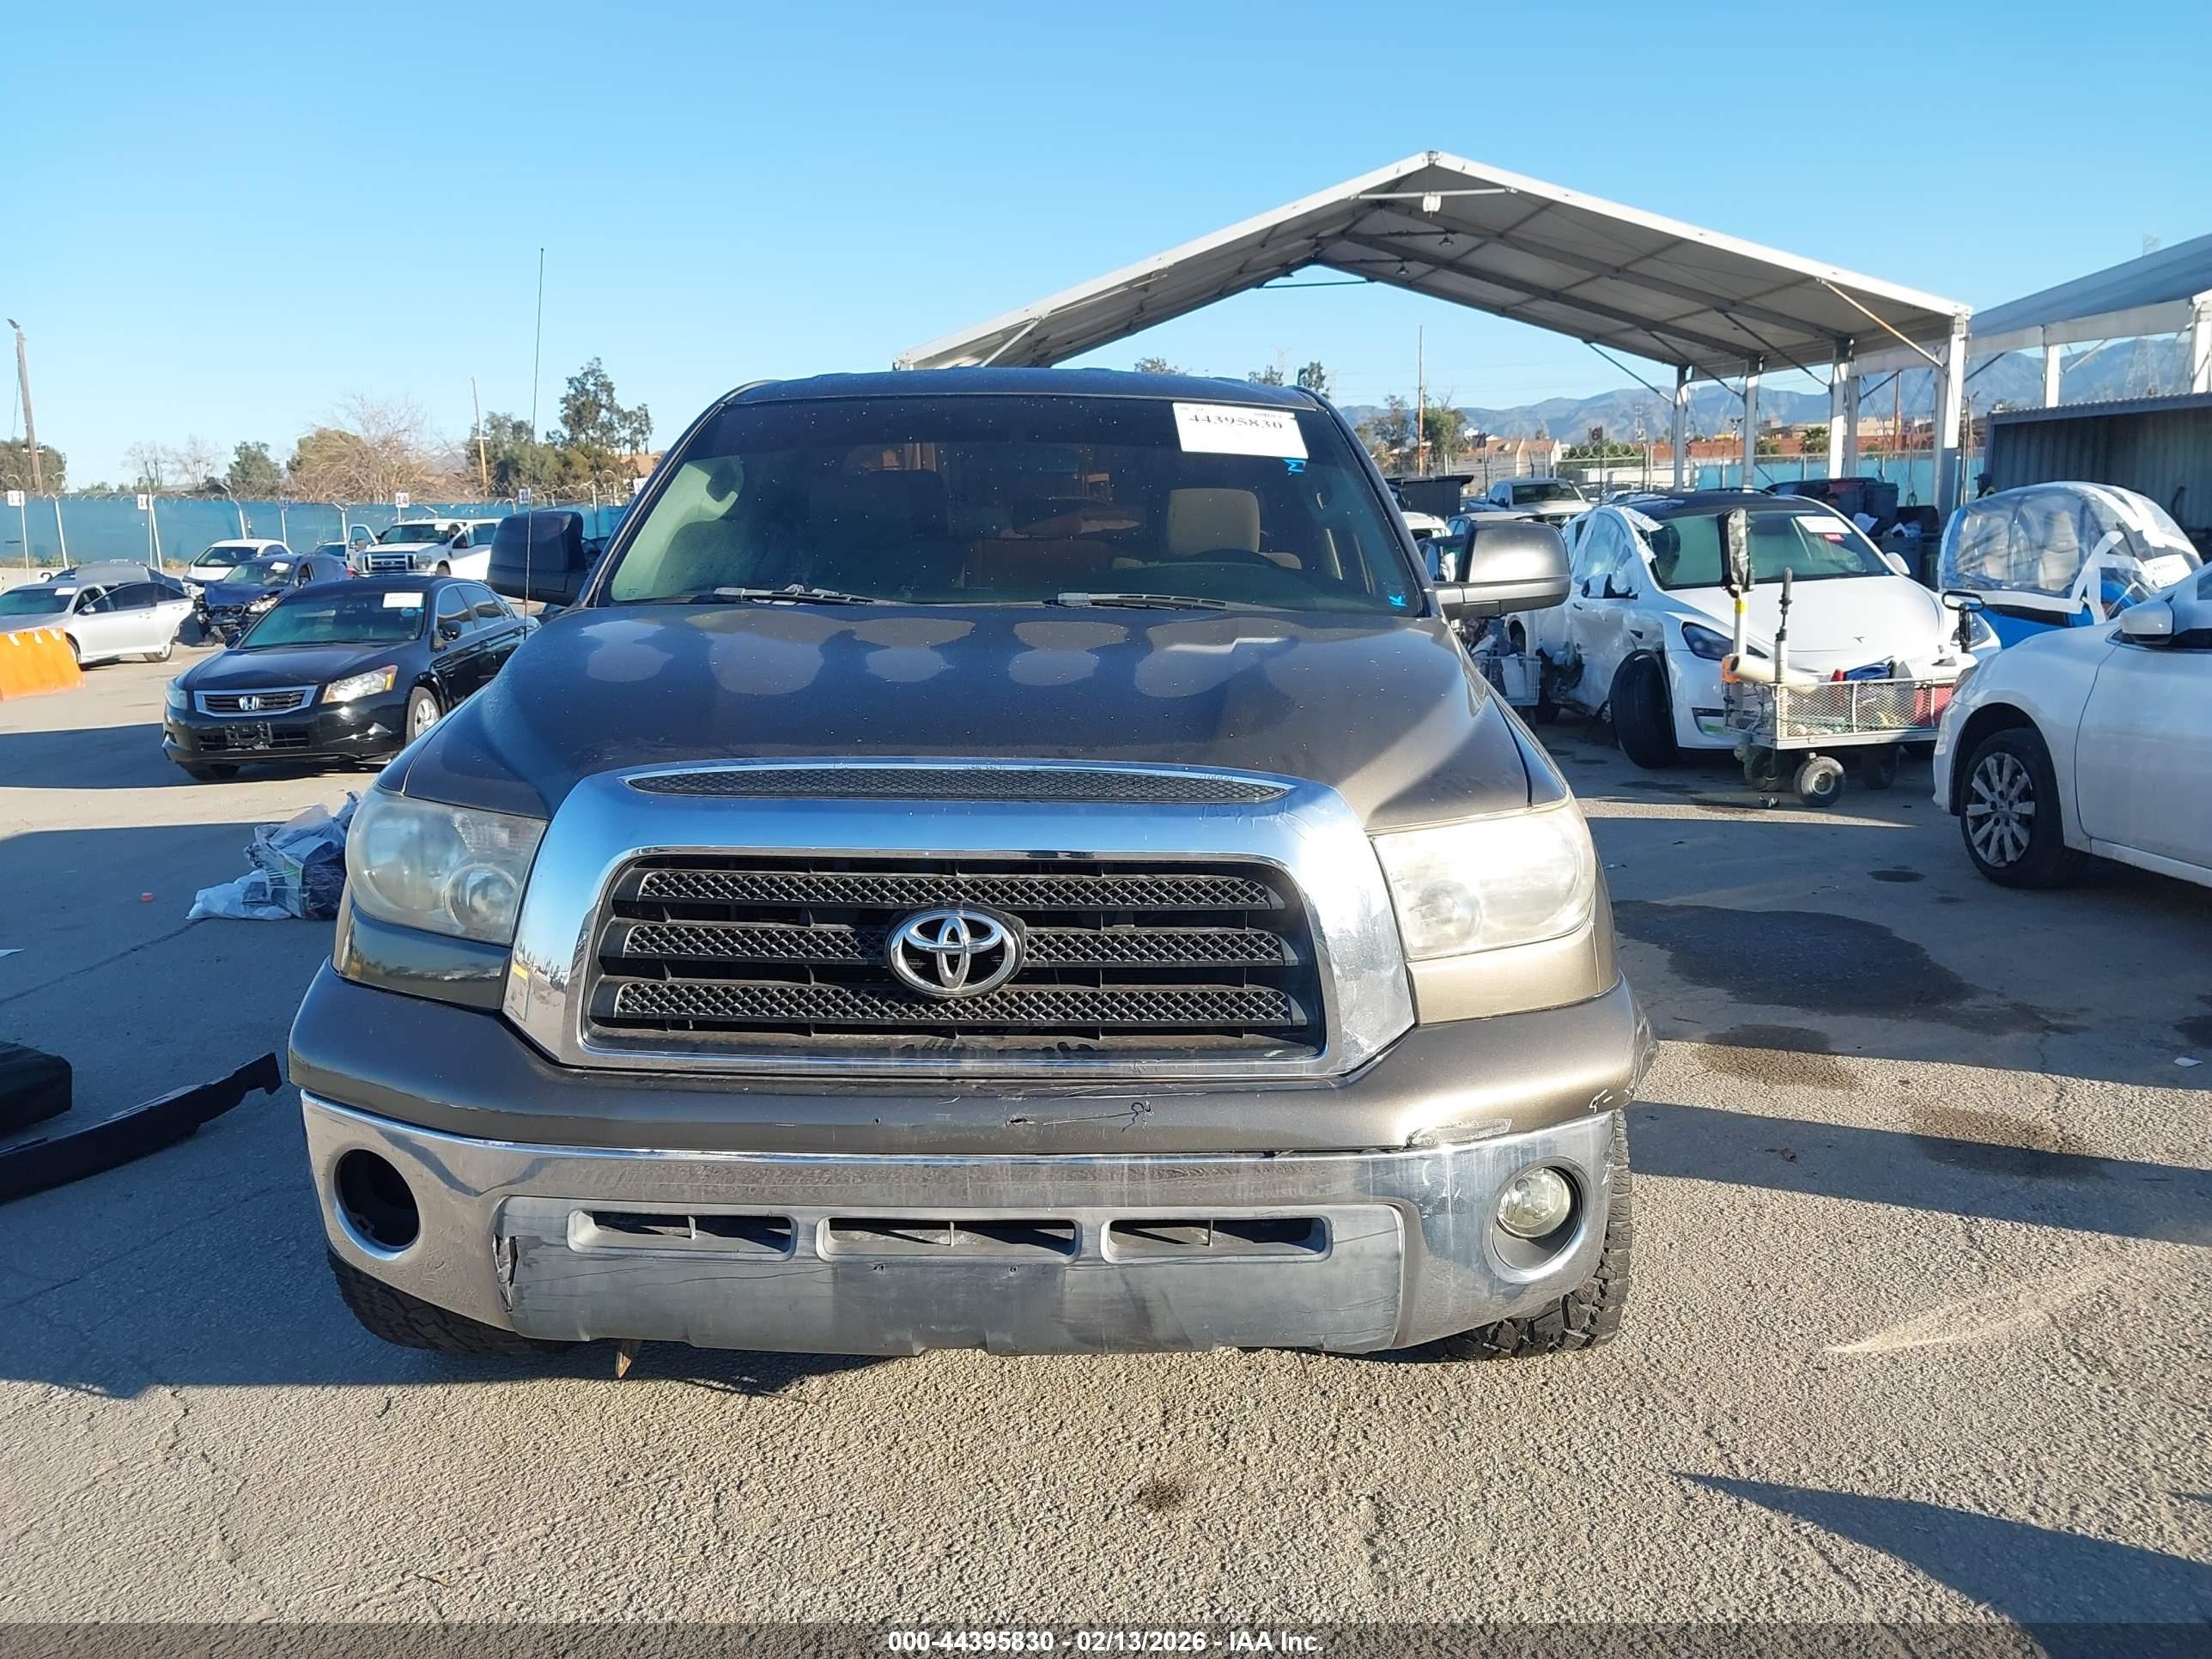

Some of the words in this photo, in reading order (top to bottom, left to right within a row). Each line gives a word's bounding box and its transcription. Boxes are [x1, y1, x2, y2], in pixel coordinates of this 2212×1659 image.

[1189, 414, 1283, 429] 44395830
[1592, 427, 1601, 441] 6
[396, 495, 408, 506] 14
